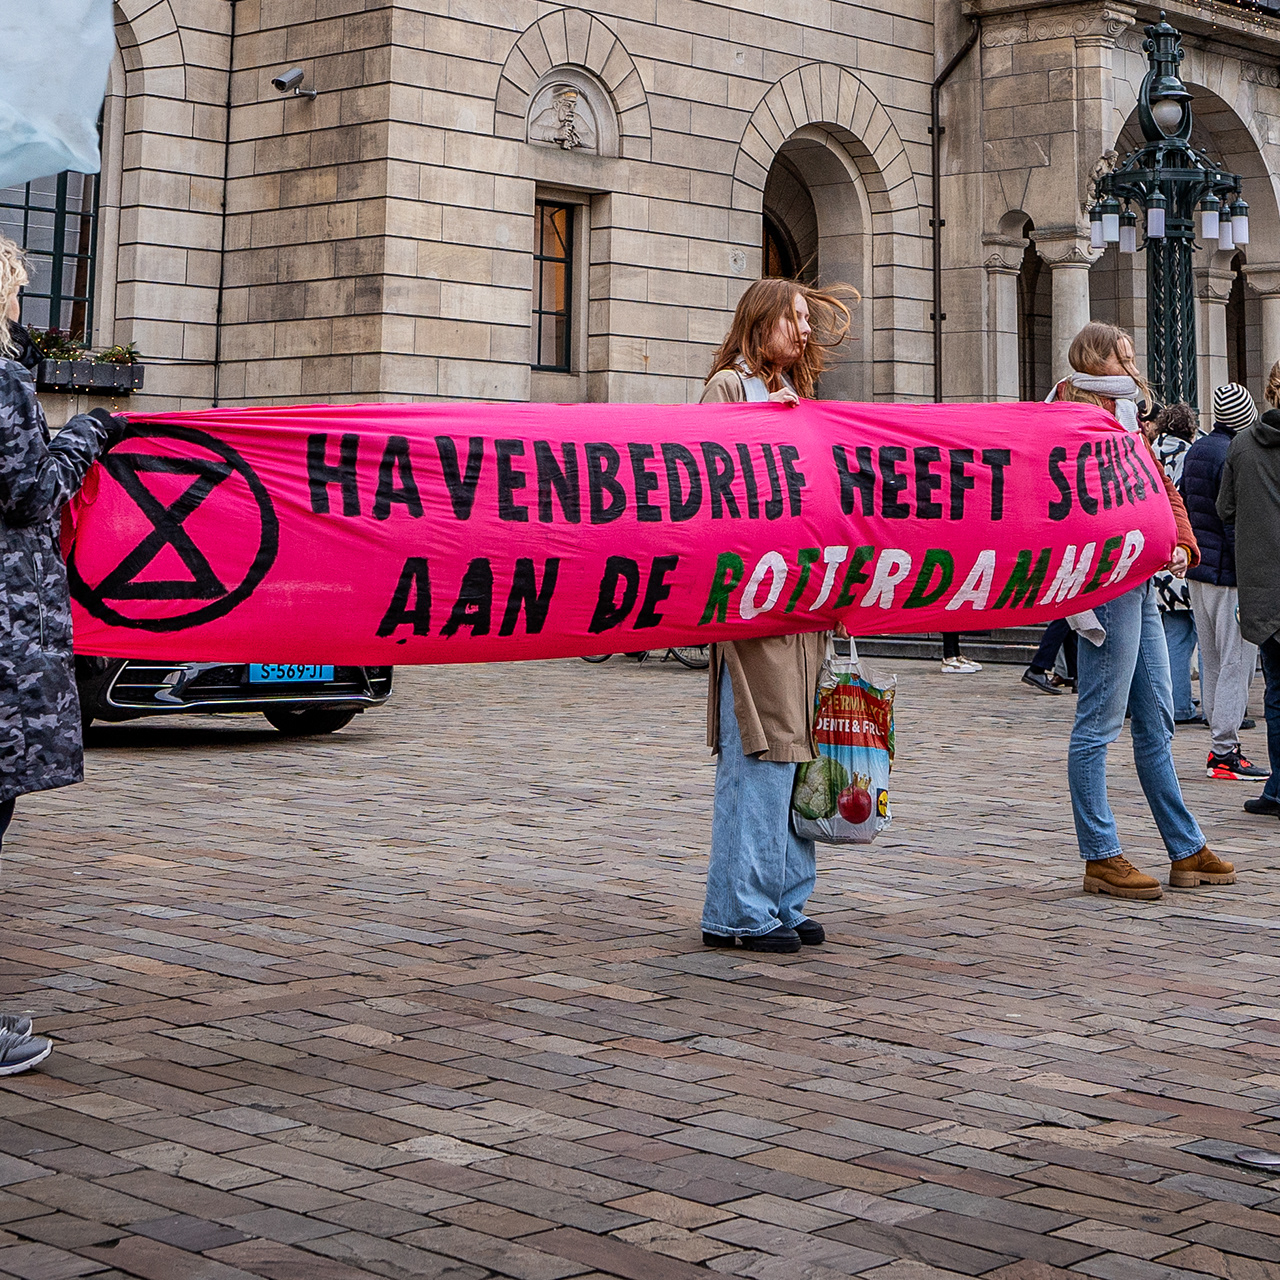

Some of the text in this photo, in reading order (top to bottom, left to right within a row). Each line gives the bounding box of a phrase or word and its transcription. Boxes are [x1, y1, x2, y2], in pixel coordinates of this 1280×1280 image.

[306, 431, 807, 525] HAVENBEDRIJF
[831, 444, 1012, 521] HEEFT
[375, 529, 1146, 641] AAN DE ROTTERDAMMER
[852, 719, 861, 733] &
